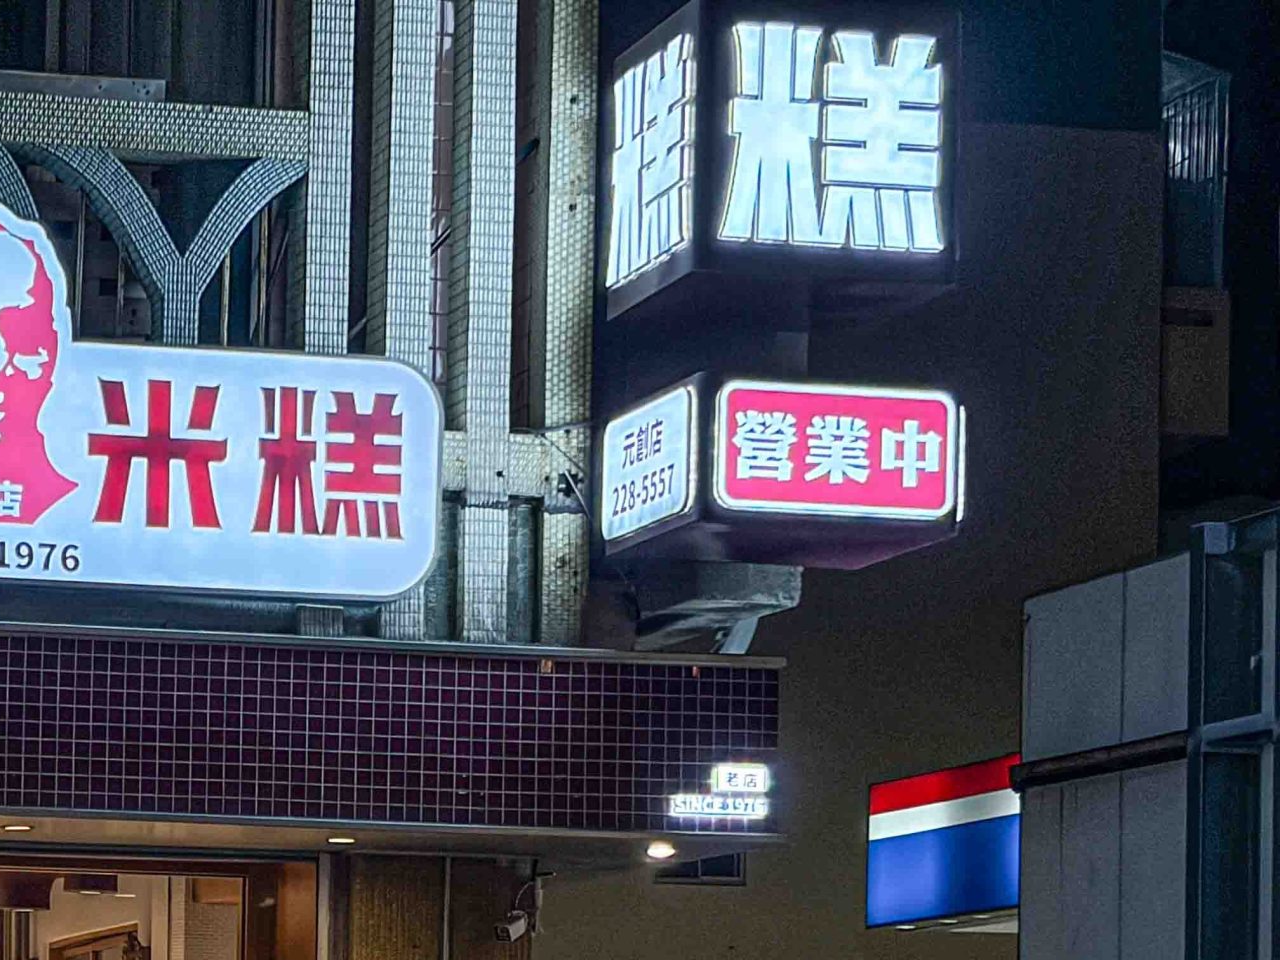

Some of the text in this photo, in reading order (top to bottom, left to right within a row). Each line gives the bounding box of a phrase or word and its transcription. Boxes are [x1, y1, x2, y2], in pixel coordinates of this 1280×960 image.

[718, 22, 944, 253] 糕
[88, 376, 406, 541] 米糕
[622, 418, 664, 469] 元創店
[731, 409, 943, 489] 營業中
[611, 462, 675, 518] 228-5557
